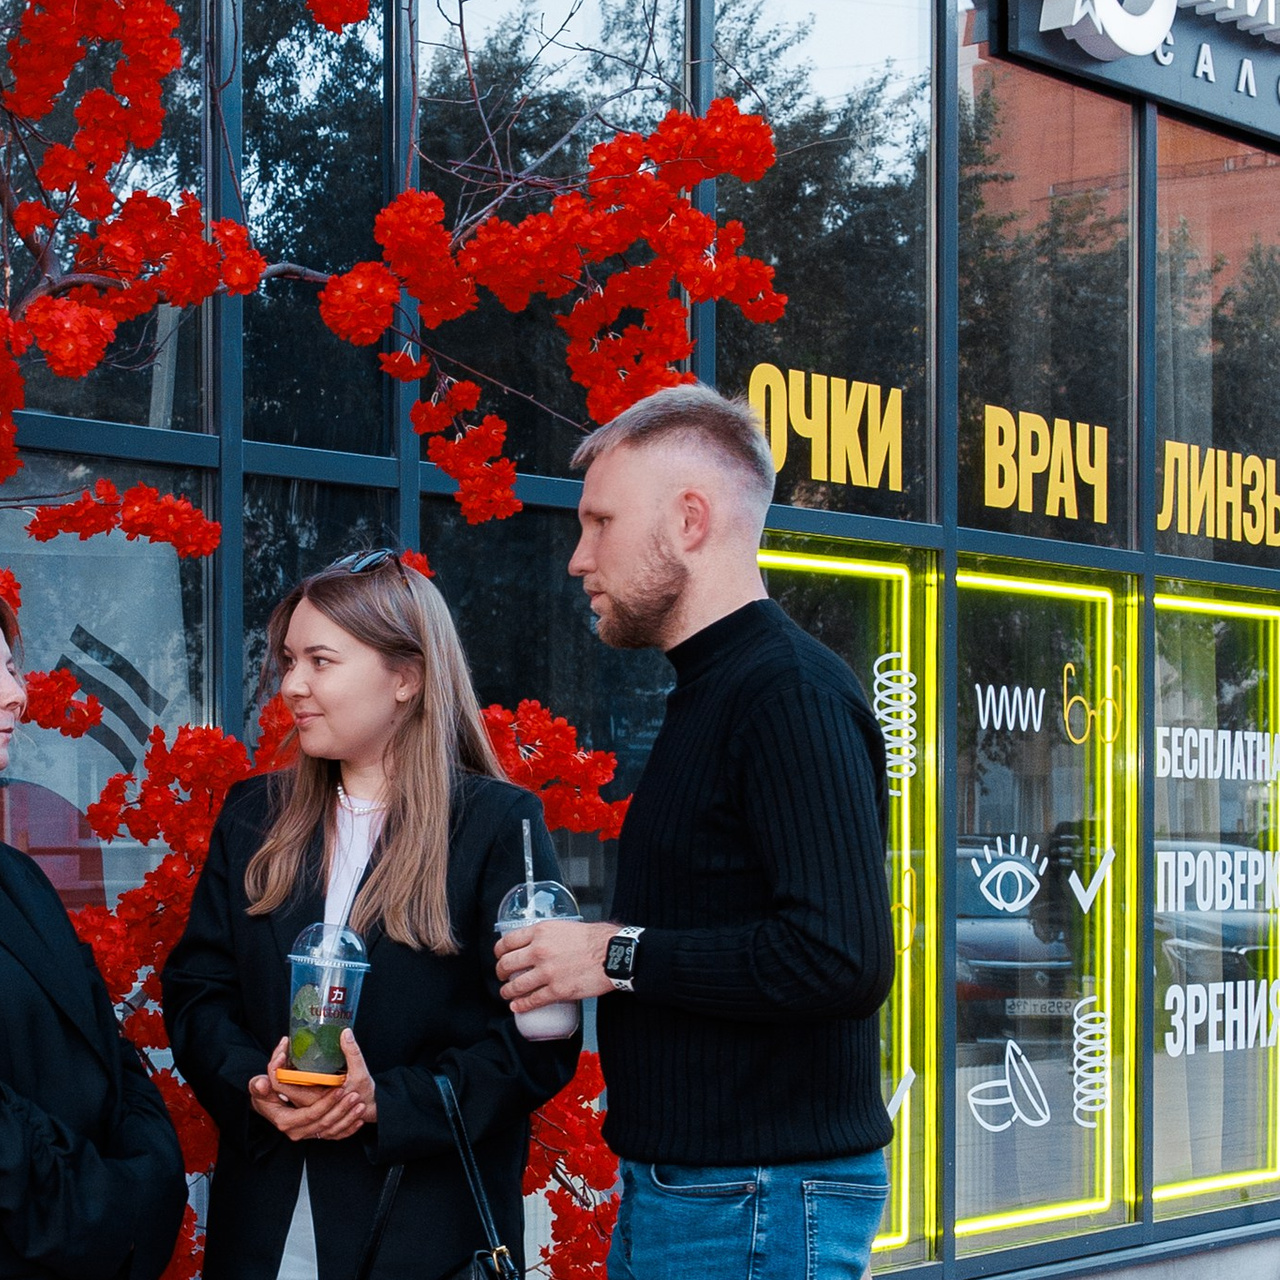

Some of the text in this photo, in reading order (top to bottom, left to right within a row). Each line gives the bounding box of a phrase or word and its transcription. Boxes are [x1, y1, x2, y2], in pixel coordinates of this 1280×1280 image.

[1155, 31, 1280, 106] САЛ
[748, 362, 903, 492] ОЧКИ
[984, 404, 1108, 524] ВРАЧ
[310, 1004, 353, 1020] tuttoho
[1164, 979, 1280, 1057] ЗРЕНИЯ
